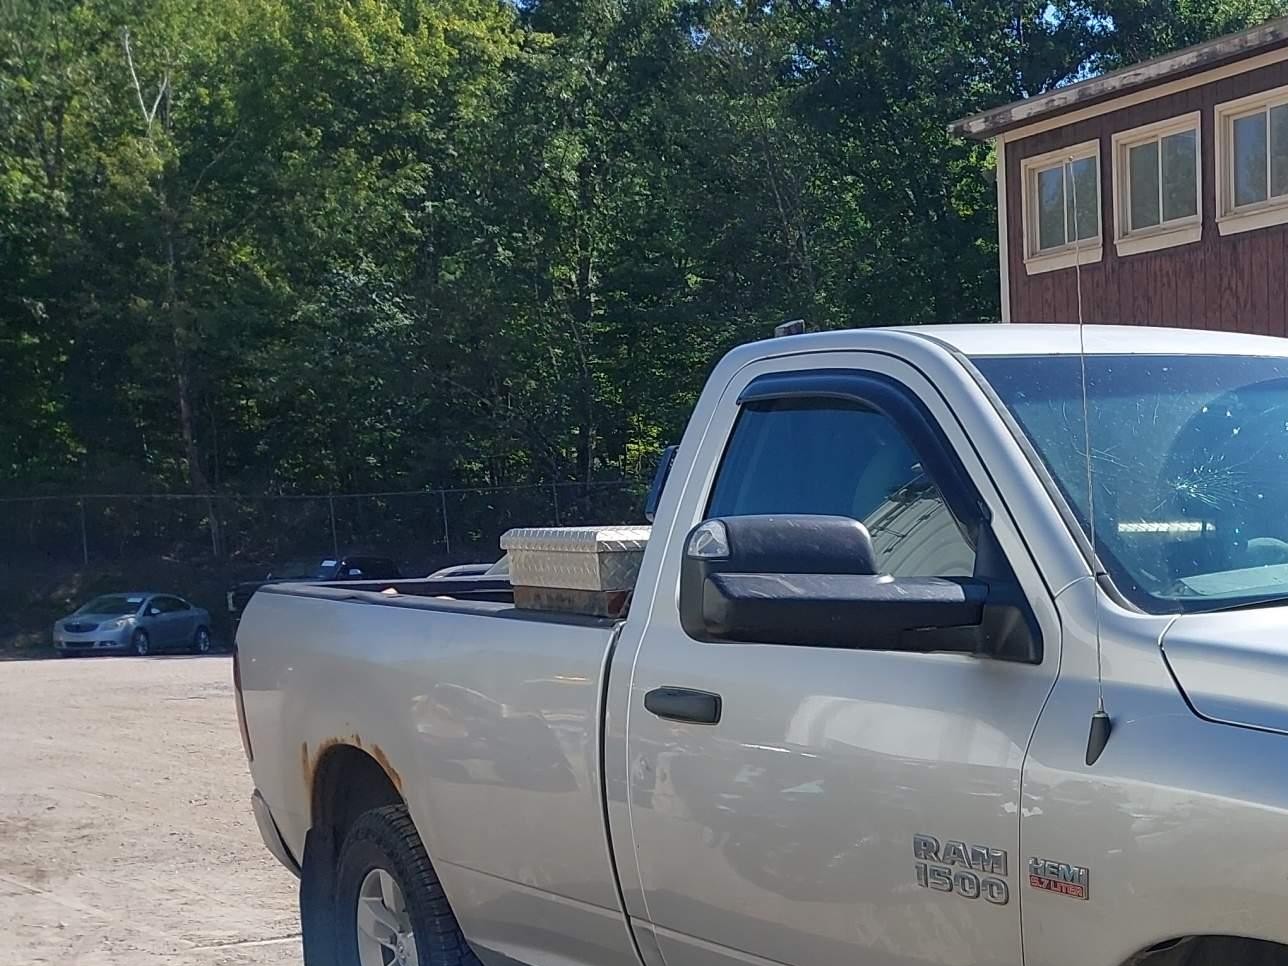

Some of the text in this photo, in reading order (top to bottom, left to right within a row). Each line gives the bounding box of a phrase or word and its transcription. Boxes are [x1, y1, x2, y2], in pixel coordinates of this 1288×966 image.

[913, 833, 1008, 876] RAM
[1028, 857, 1089, 885] HEMI
[914, 862, 1010, 905] 1500
[1030, 875, 1084, 898] 5.7 LITER
